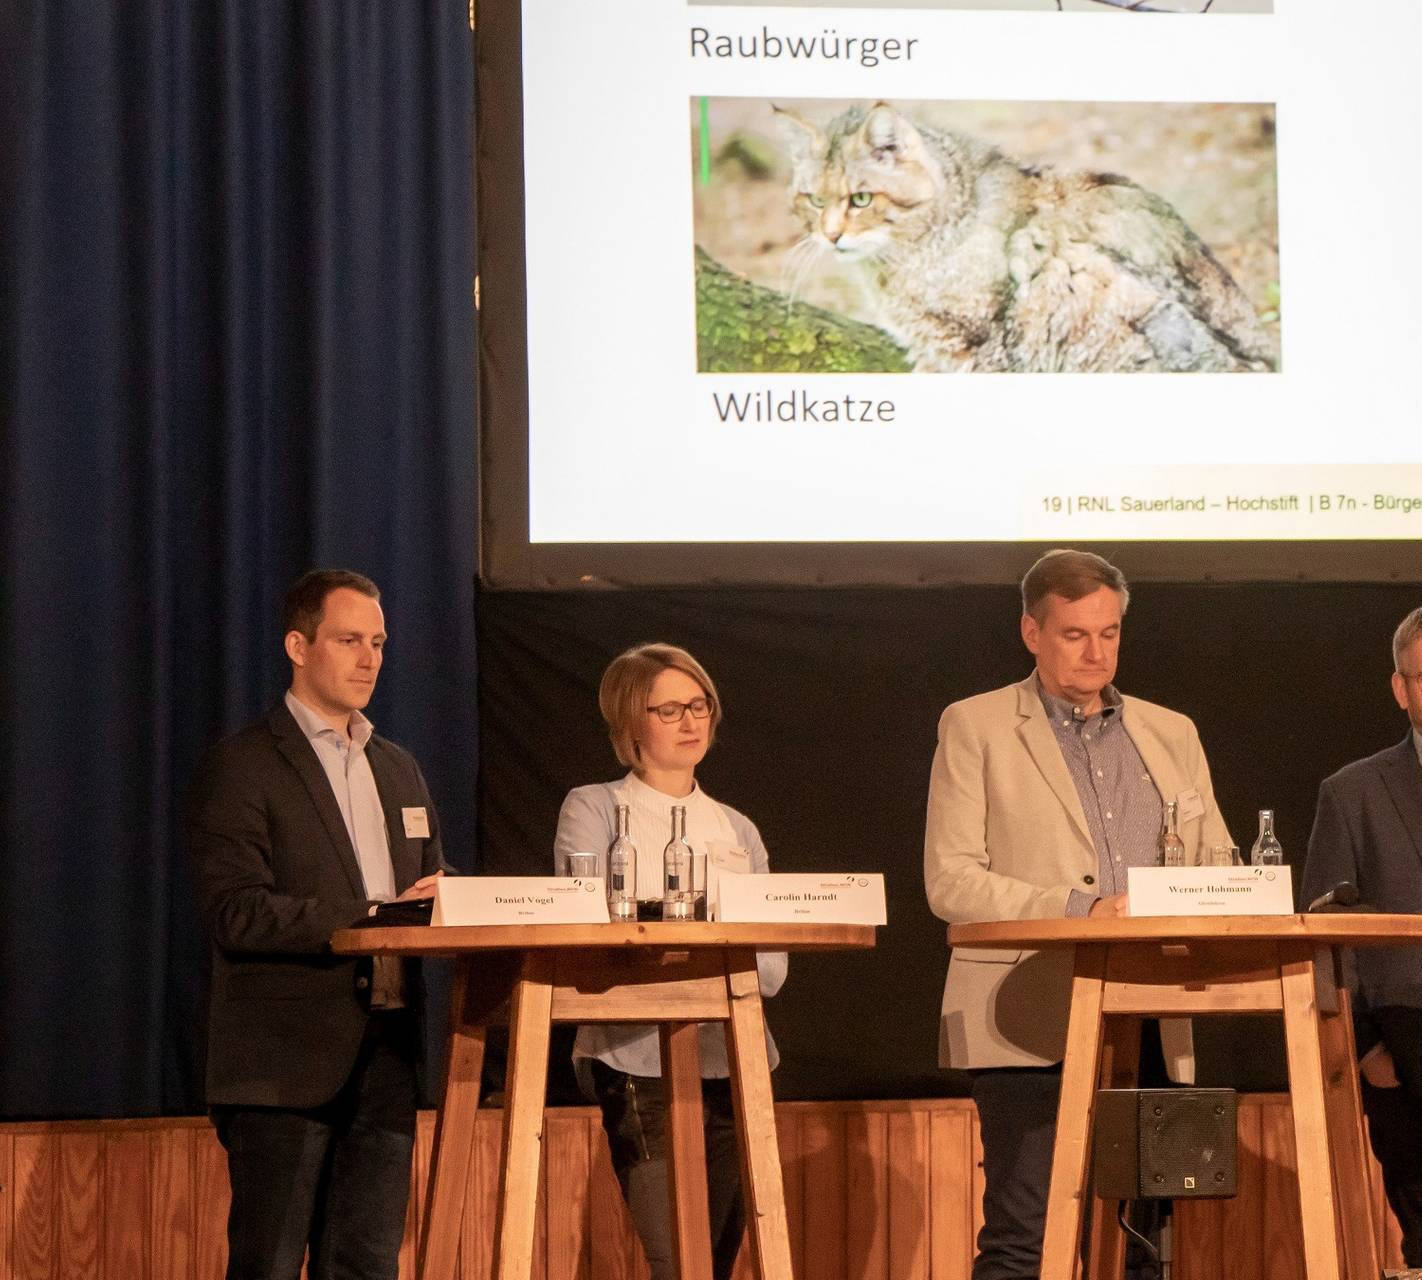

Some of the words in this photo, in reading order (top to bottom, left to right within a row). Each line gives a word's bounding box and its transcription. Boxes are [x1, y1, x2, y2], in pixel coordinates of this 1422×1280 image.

[690, 25, 919, 68] Raubwürger
[712, 389, 896, 423] Wildkatze
[1042, 496, 1062, 513] 19
[1077, 496, 1115, 512] RNL
[1120, 495, 1206, 512] Sauerland
[1226, 494, 1299, 511] Hochstift
[1319, 494, 1332, 511] B
[1336, 494, 1357, 510] 7n
[1168, 885, 1204, 893] Werner
[1207, 885, 1252, 893] Hohmann
[495, 896, 525, 904] Daniel
[527, 896, 555, 905] Vogel
[765, 893, 801, 901] Carolin
[803, 893, 837, 901] Harndt
